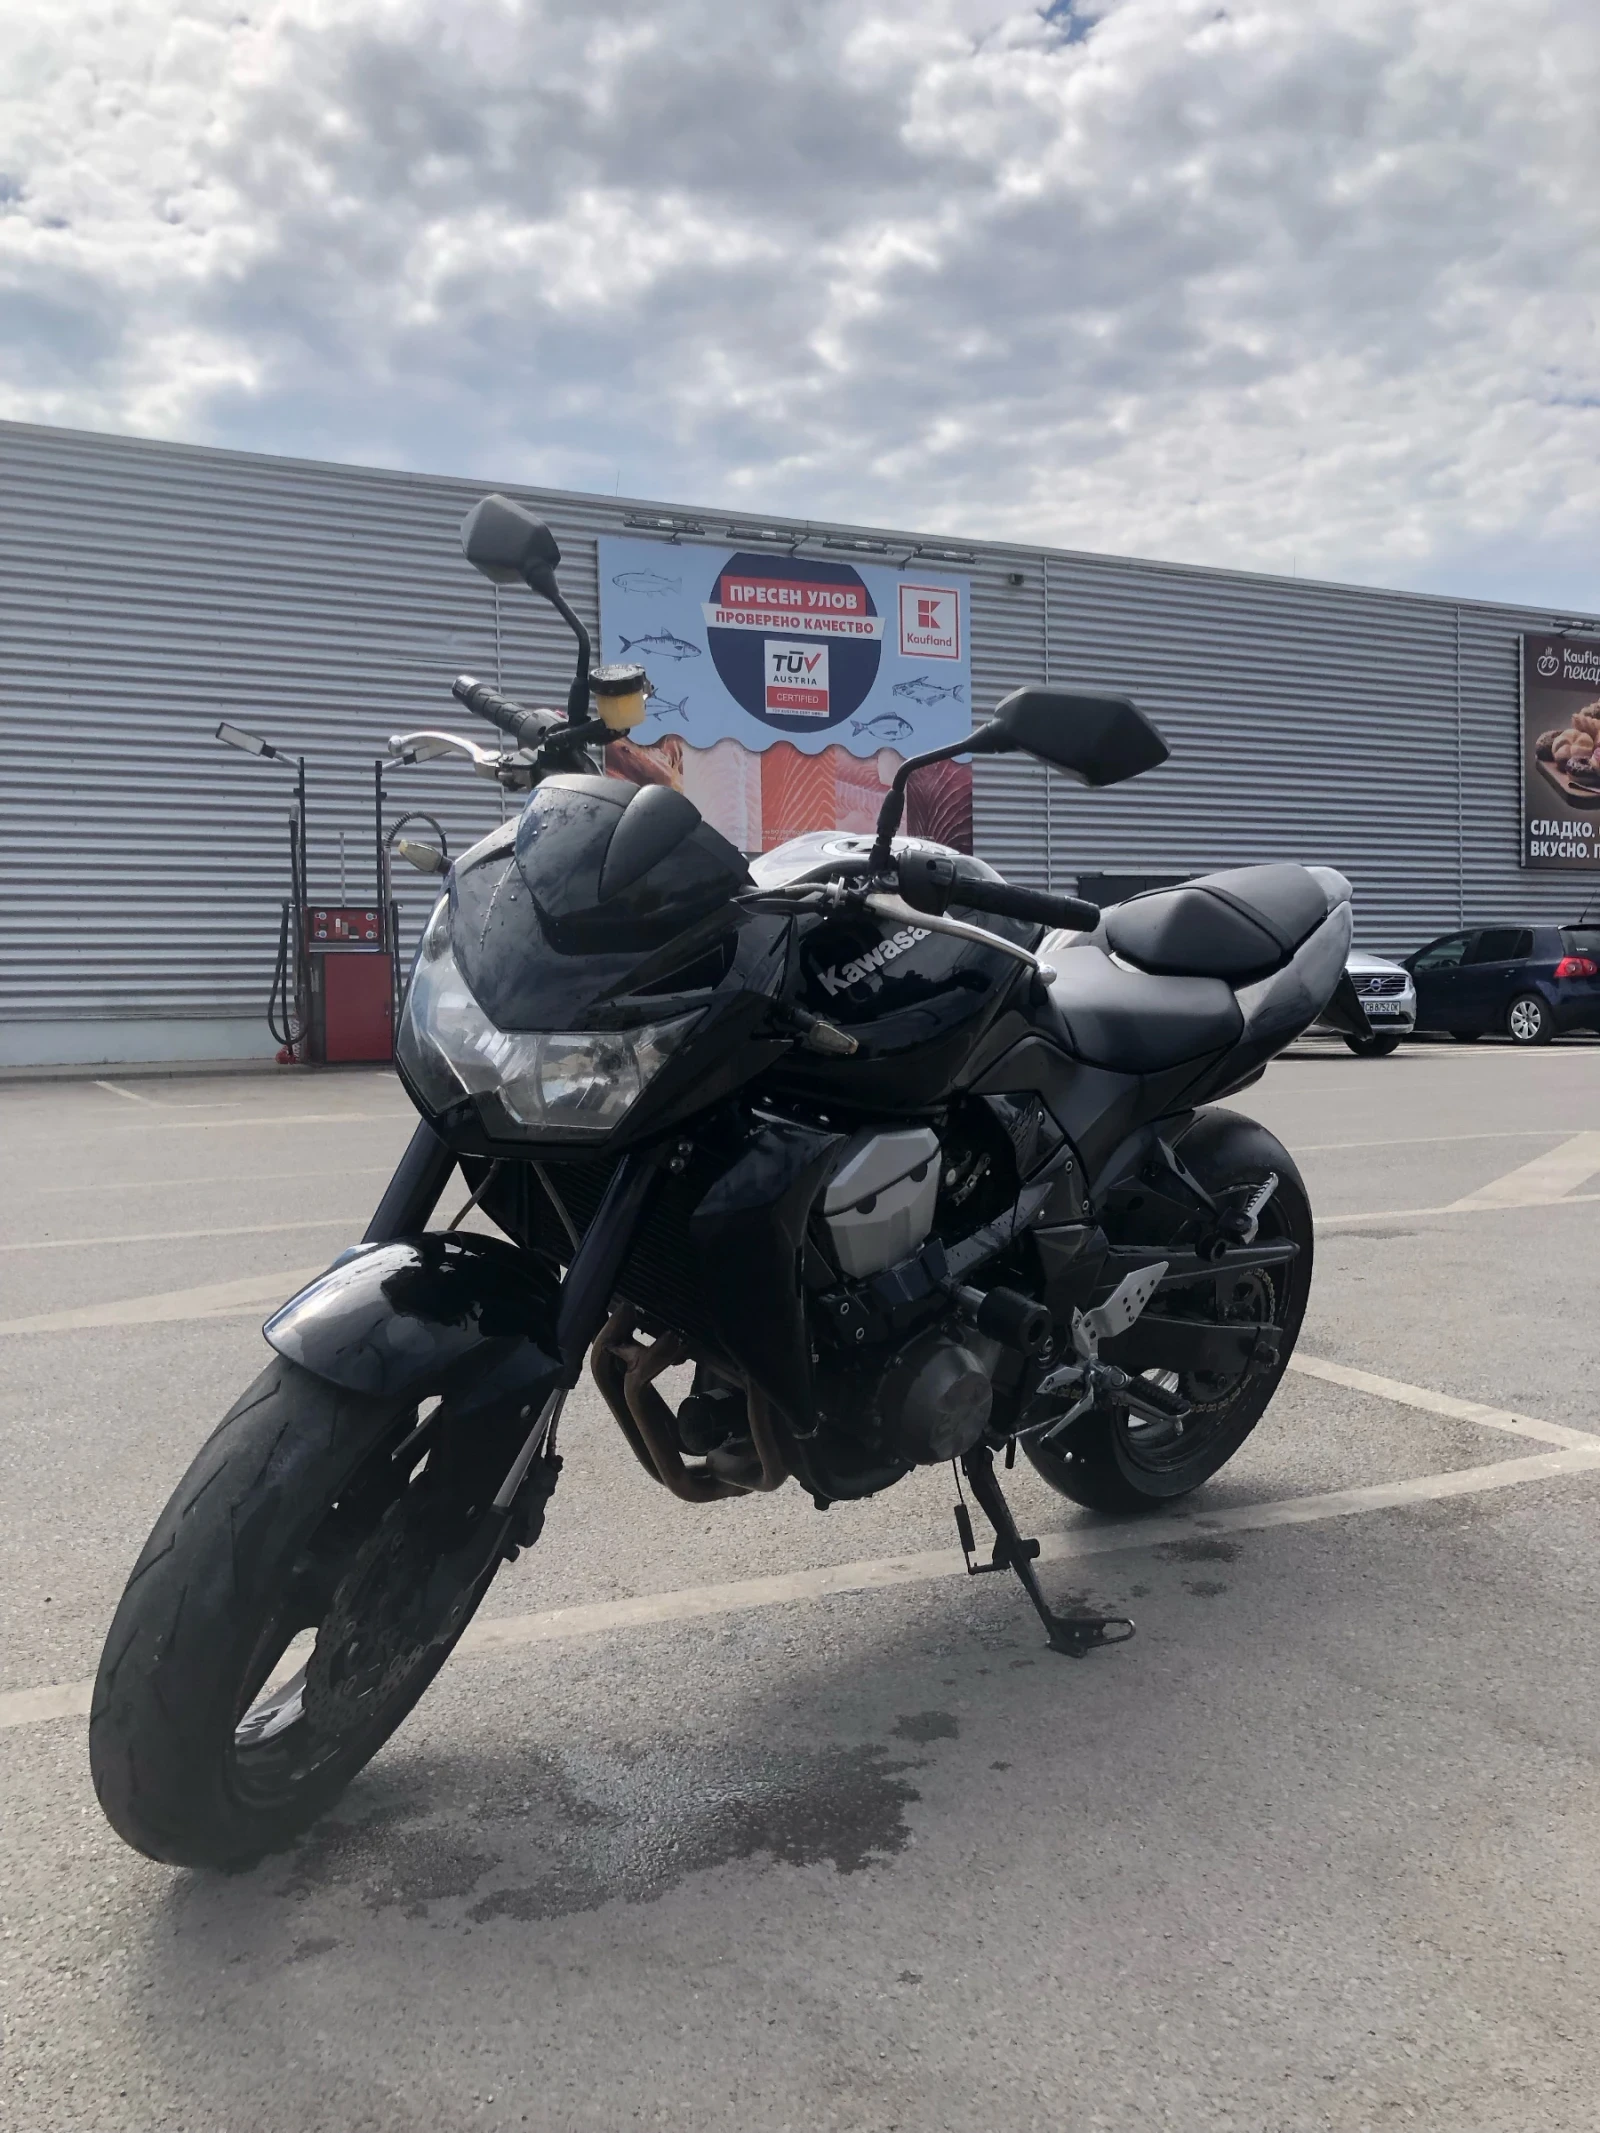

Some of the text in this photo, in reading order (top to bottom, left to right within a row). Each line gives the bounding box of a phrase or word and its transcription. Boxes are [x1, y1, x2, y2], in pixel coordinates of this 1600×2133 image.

[730, 585, 857, 609] ПРЕСЕН УЛОВ
[715, 611, 874, 634] ПРОВЕРЕНО КАЧЕСТВО
[907, 633, 952, 647] Kaufland
[1564, 648, 1600, 666] Kaufla
[773, 675, 817, 685] AUSTRIA
[776, 693, 819, 704] CERTIFIED
[1530, 820, 1595, 840] СЛАДКО.
[1530, 841, 1590, 859] ВКУСНО.
[817, 926, 932, 996] Kawasa
